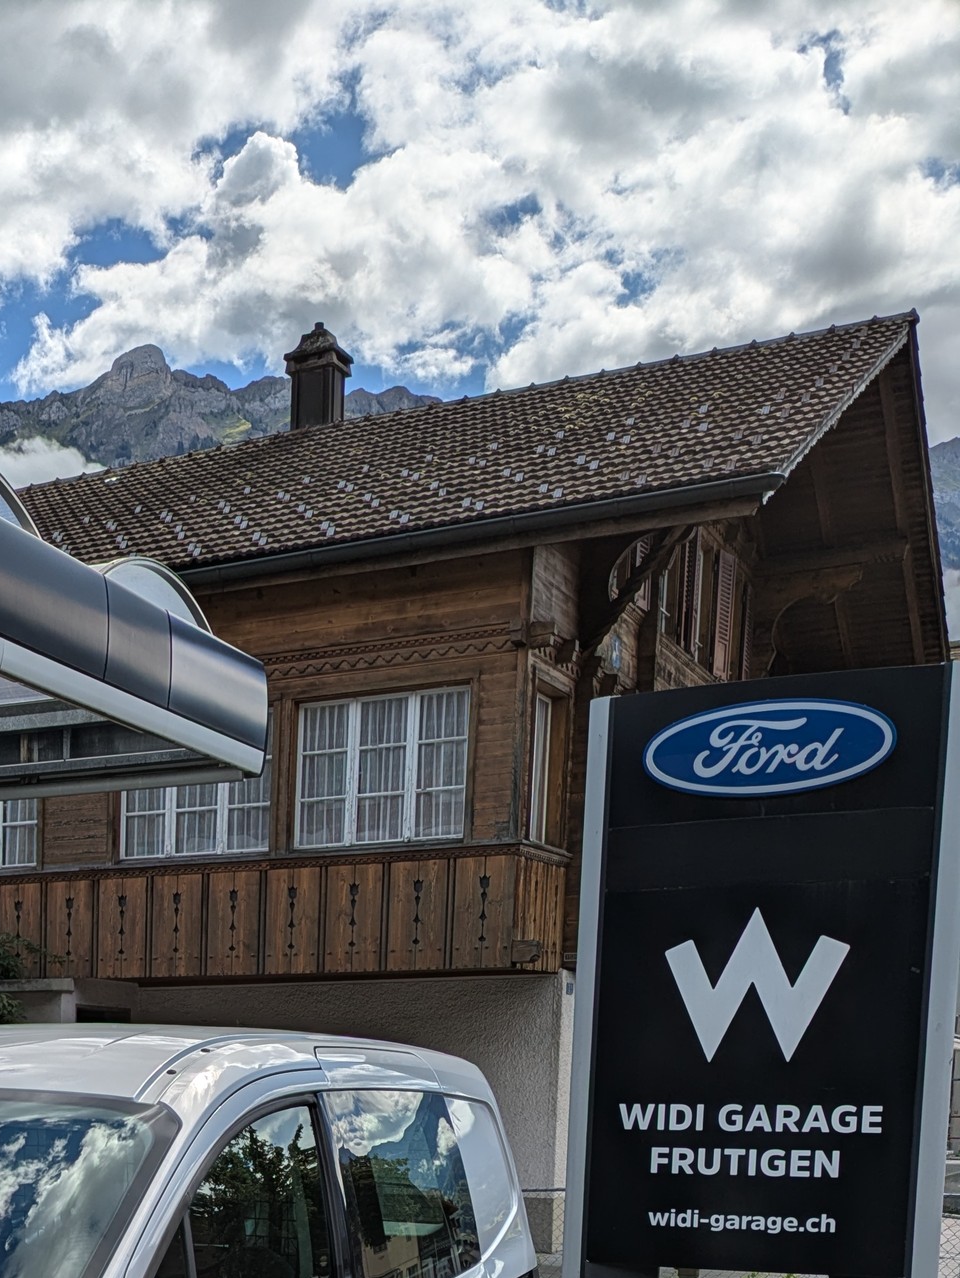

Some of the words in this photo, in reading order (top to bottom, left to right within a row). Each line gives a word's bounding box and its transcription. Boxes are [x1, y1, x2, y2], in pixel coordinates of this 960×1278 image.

[692, 716, 845, 776] Ford
[664, 906, 851, 1063] W
[618, 1103, 705, 1131] WIDI
[717, 1103, 884, 1134] GARAGE
[649, 1147, 841, 1179] FRUTIGEN
[647, 1208, 837, 1234] widi-garage.ch
